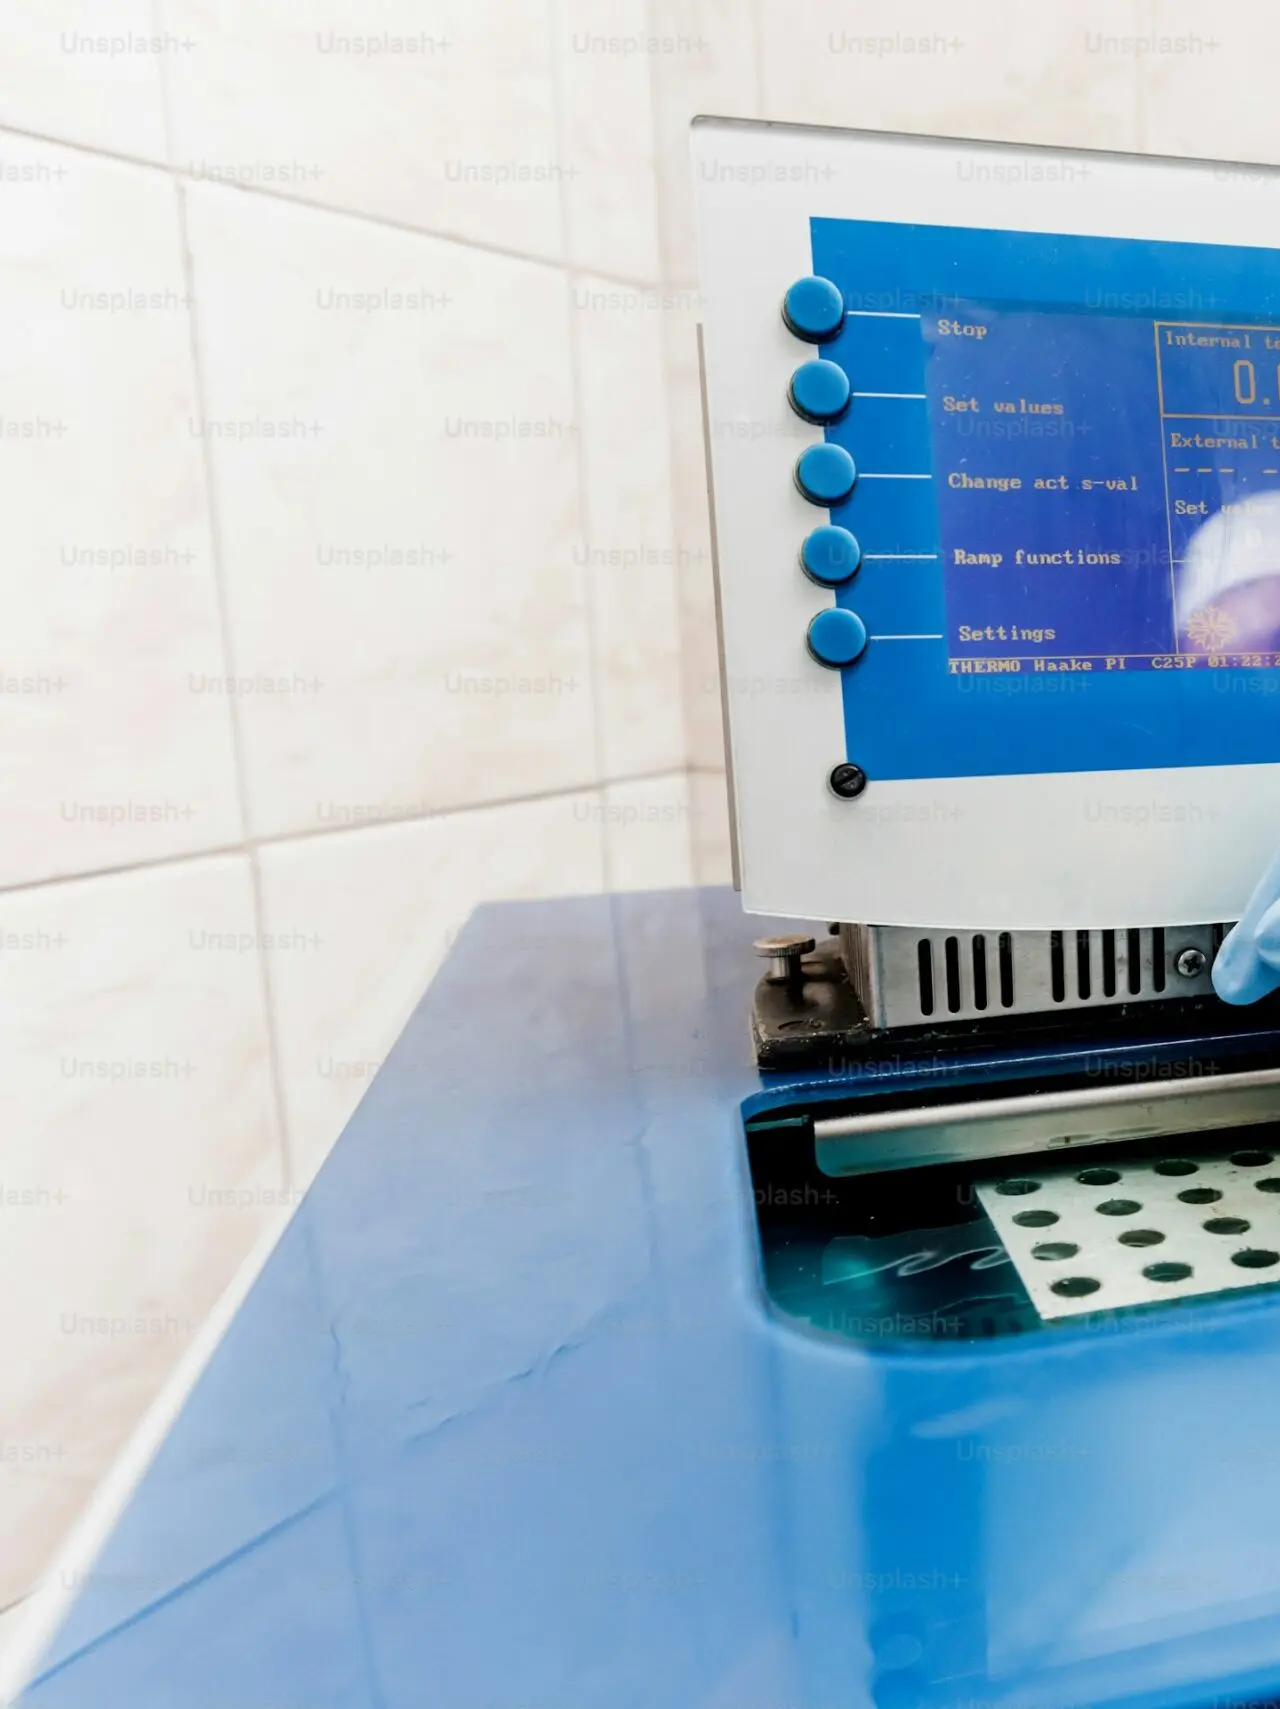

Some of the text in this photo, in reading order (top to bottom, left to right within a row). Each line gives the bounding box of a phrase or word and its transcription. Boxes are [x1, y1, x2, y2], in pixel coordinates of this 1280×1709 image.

[937, 319, 988, 340] Stop
[1165, 330, 1251, 349] Internal
[942, 396, 1064, 415] Set values
[1170, 432, 1259, 449] External
[948, 472, 1138, 492] Change act s-val
[1175, 499, 1209, 515] Set
[954, 549, 1003, 568] Ramp
[1015, 549, 1121, 566] functions
[958, 625, 1056, 643] Settings
[949, 659, 1021, 674] THERMO
[1034, 658, 1093, 672] Haake
[1151, 655, 1197, 669] C25P
